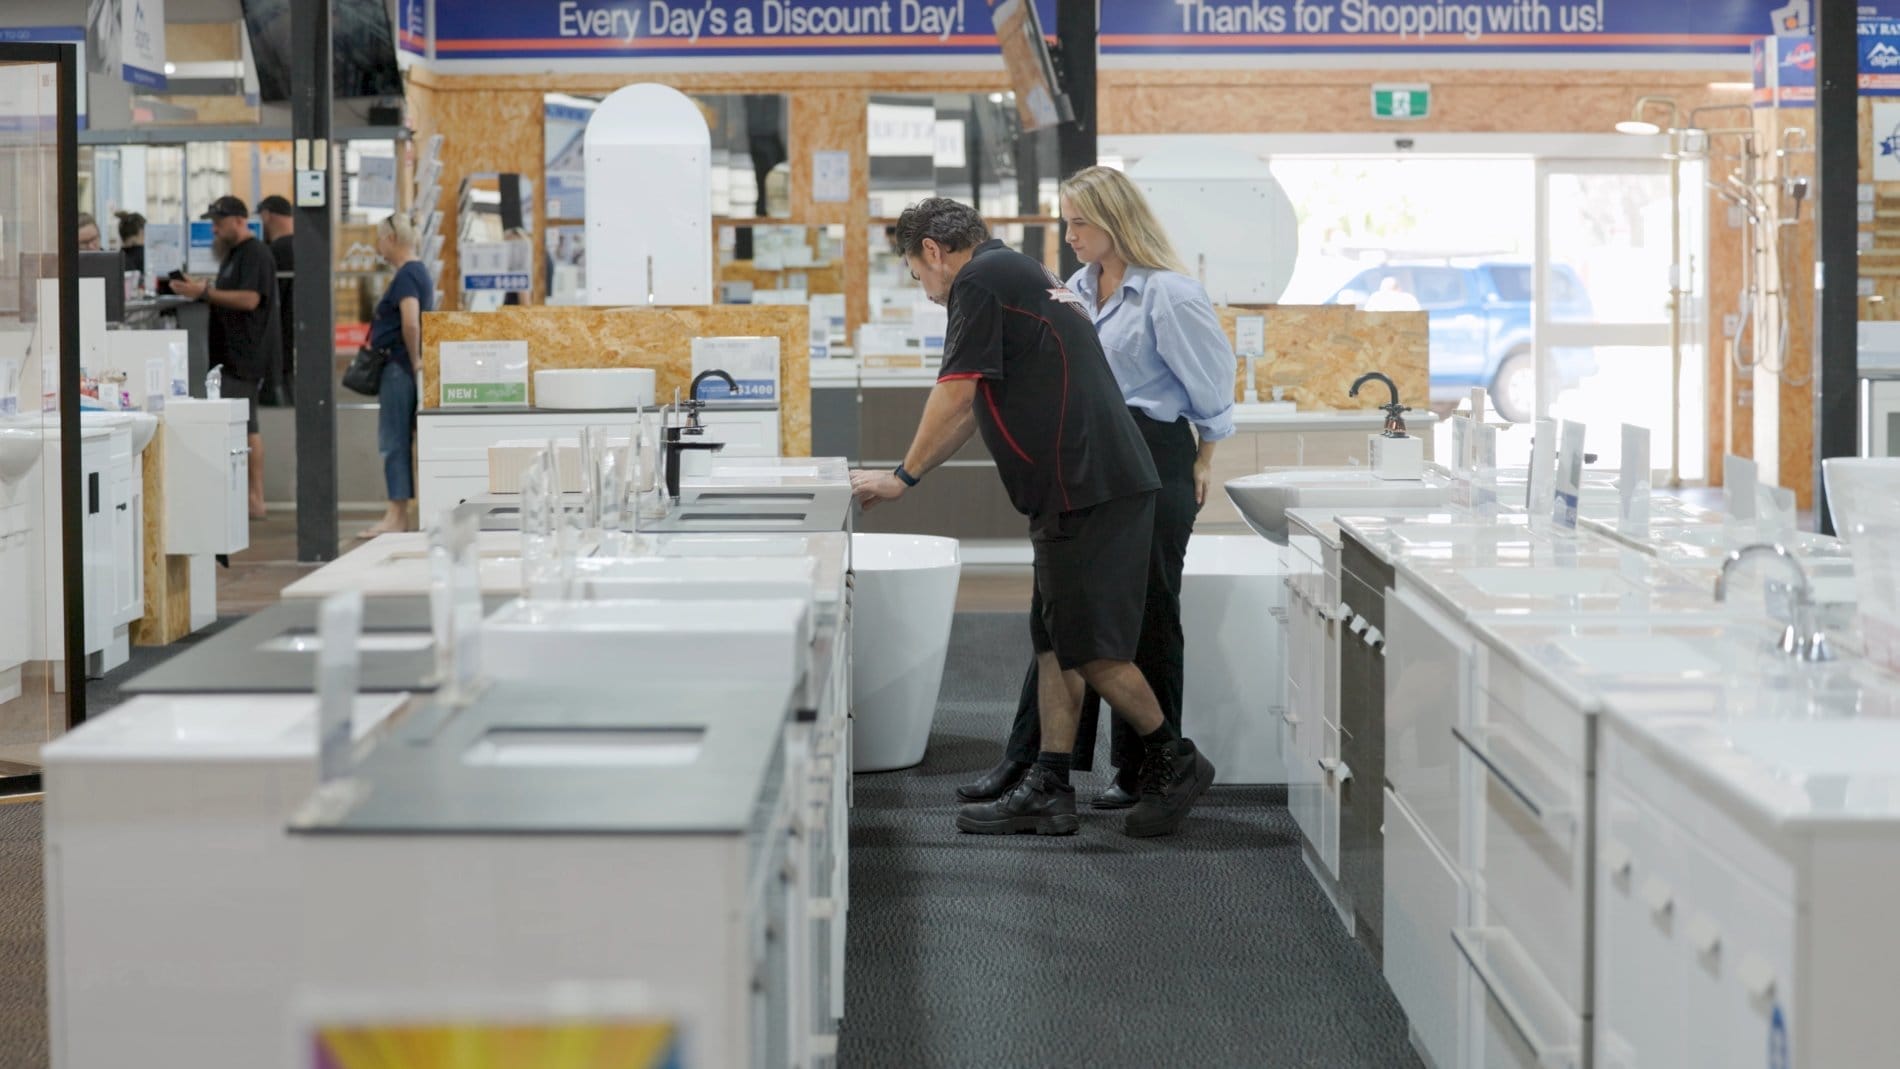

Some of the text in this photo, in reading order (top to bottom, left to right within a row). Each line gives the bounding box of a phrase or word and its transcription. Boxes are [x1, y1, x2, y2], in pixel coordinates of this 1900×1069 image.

[560, 0, 964, 43] Every Day's a Discount Day!
[1175, 0, 1604, 41] Thanks for Shopping with us!
[447, 388, 478, 400] NEW!
